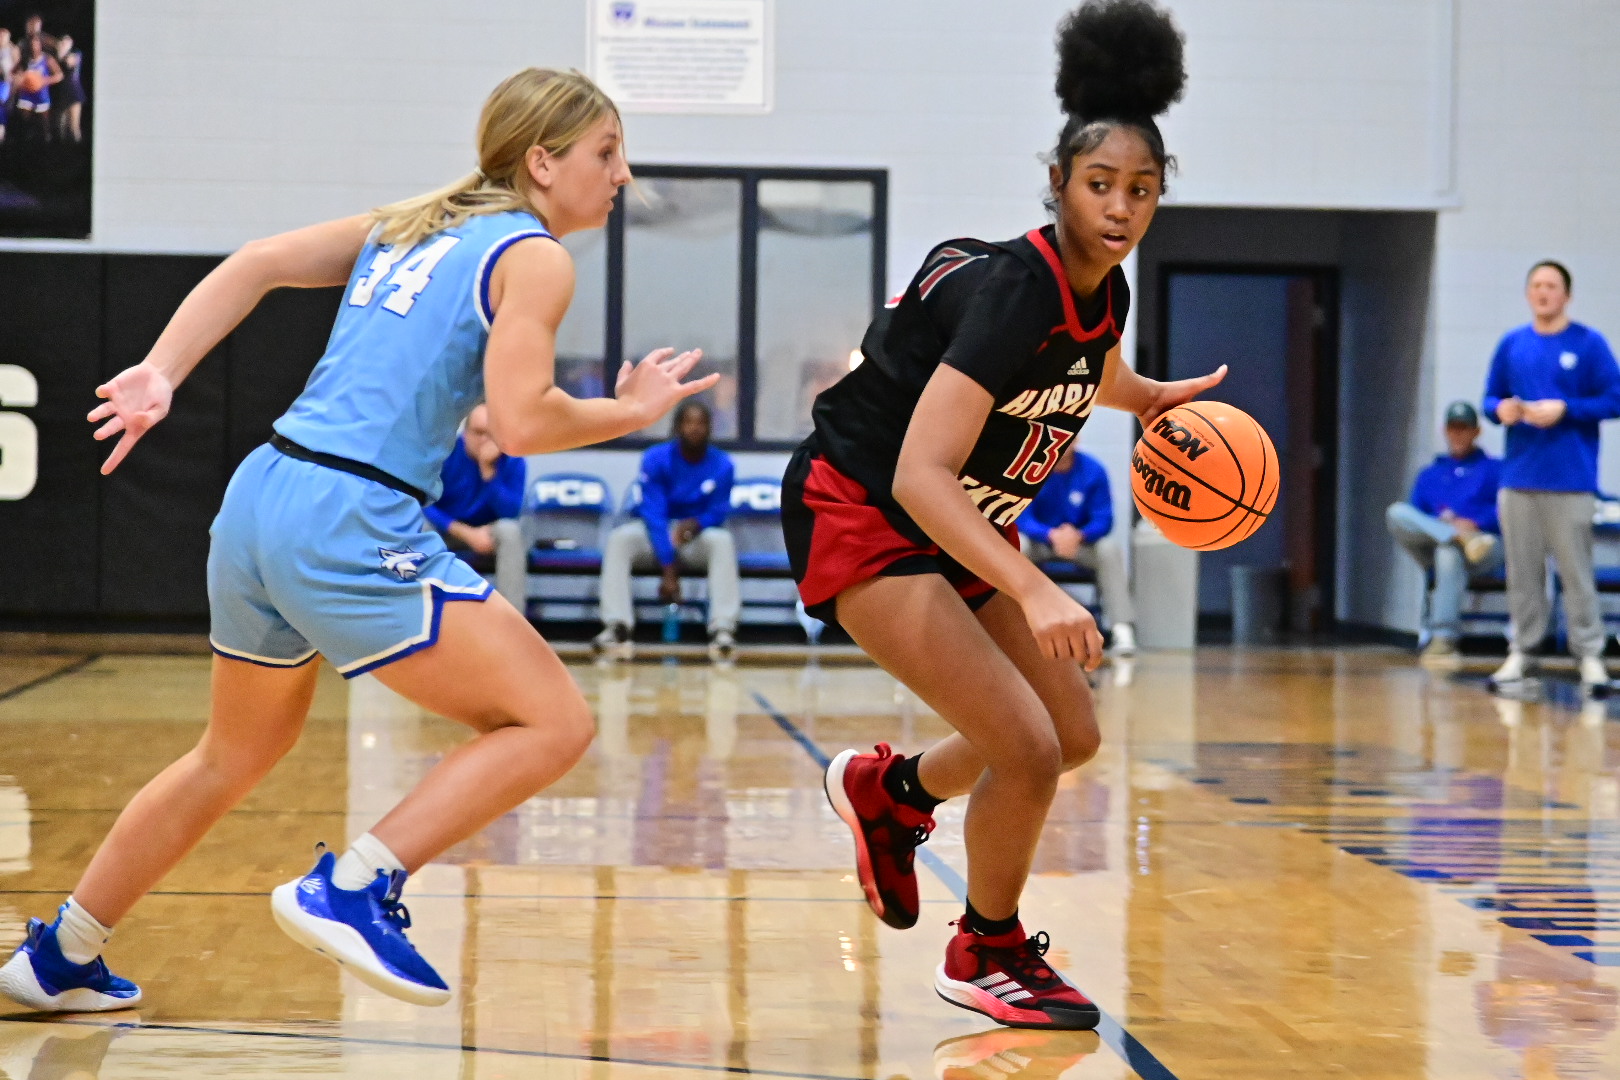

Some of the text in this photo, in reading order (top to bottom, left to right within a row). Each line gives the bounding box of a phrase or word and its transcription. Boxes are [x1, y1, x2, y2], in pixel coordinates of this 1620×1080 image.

[348, 234, 462, 318] 34
[1003, 420, 1075, 485] 13
[1151, 416, 1210, 461] NCAA
[1131, 447, 1192, 511] Wilson
